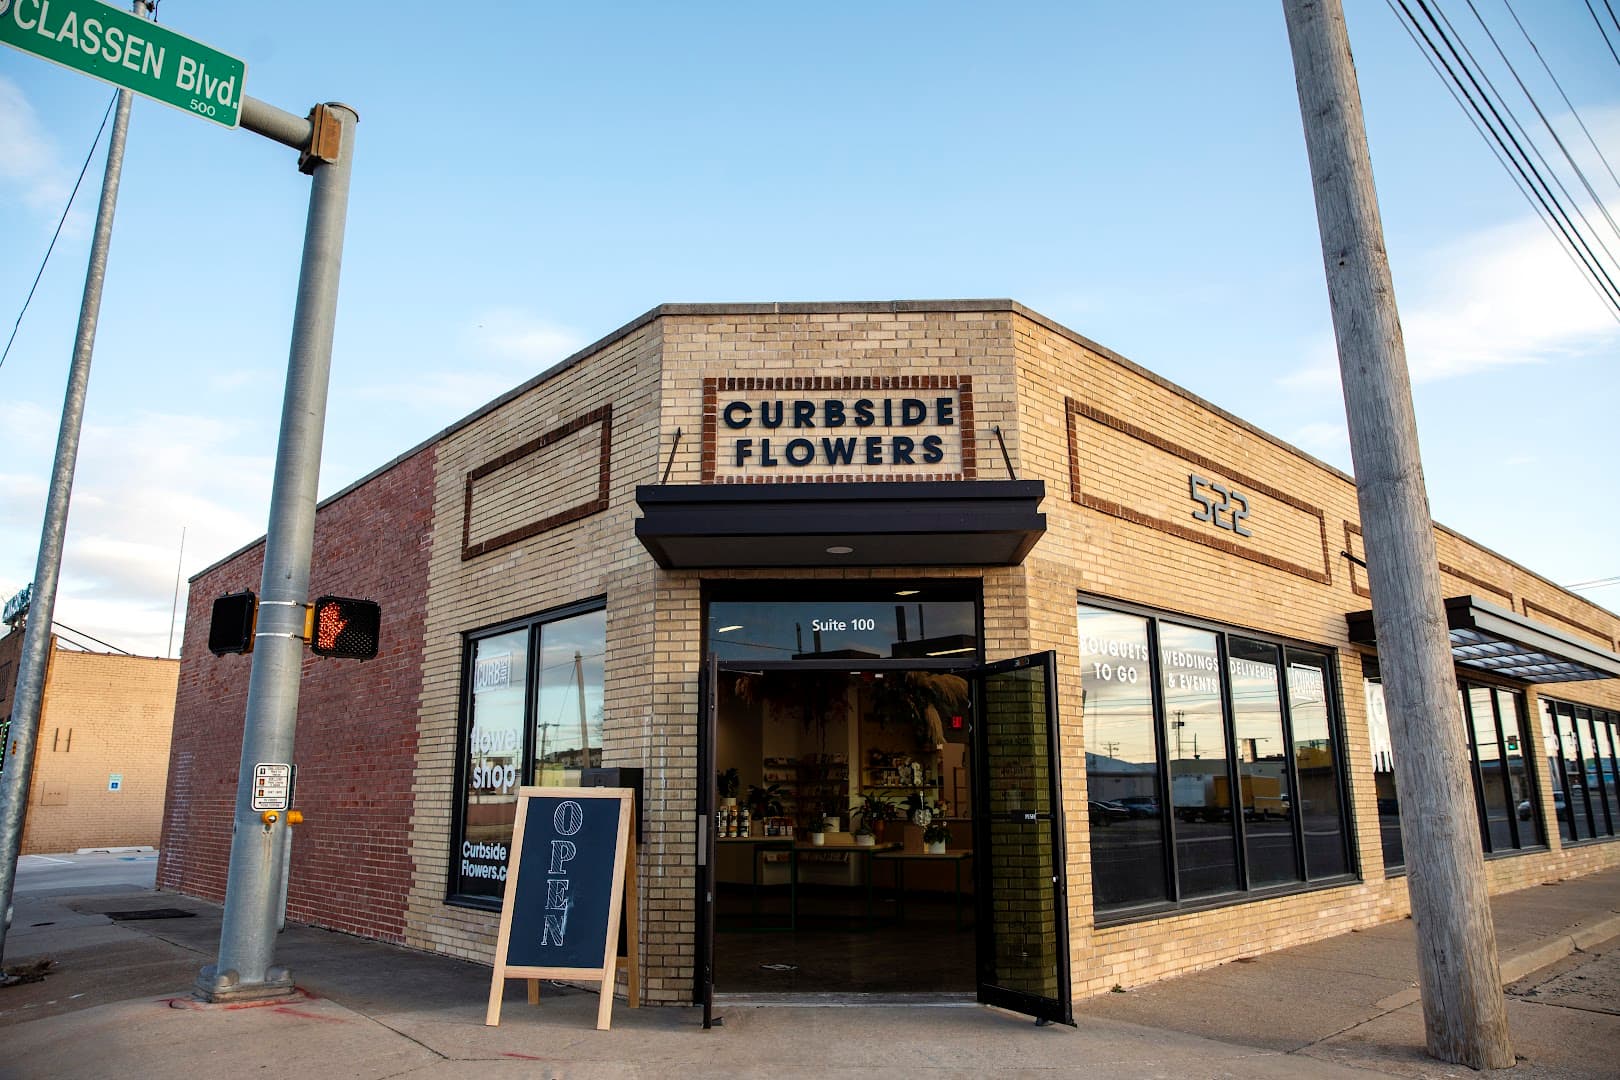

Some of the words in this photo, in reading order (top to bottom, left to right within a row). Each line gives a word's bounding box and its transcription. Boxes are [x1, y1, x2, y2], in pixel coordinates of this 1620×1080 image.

[13, 0, 165, 80] CLASSEN
[176, 55, 238, 109] Blvd.
[189, 99, 216, 117] 500
[723, 397, 954, 430] CURBSIDE
[736, 435, 944, 467] FLOWERS
[1188, 474, 1252, 537] 522
[812, 618, 847, 632] Suite
[851, 618, 875, 632] 100
[1080, 635, 1148, 662] BOUQUETS
[1162, 649, 1219, 673] WEDDINGS
[478, 661, 500, 688] CURB
[1094, 662, 1112, 680] TO
[1117, 665, 1137, 684] GO
[1168, 672, 1176, 688] &
[1180, 674, 1218, 693] EVENTS
[473, 758, 516, 794] shop
[462, 840, 507, 860] Curbside
[540, 800, 583, 947] OPEN
